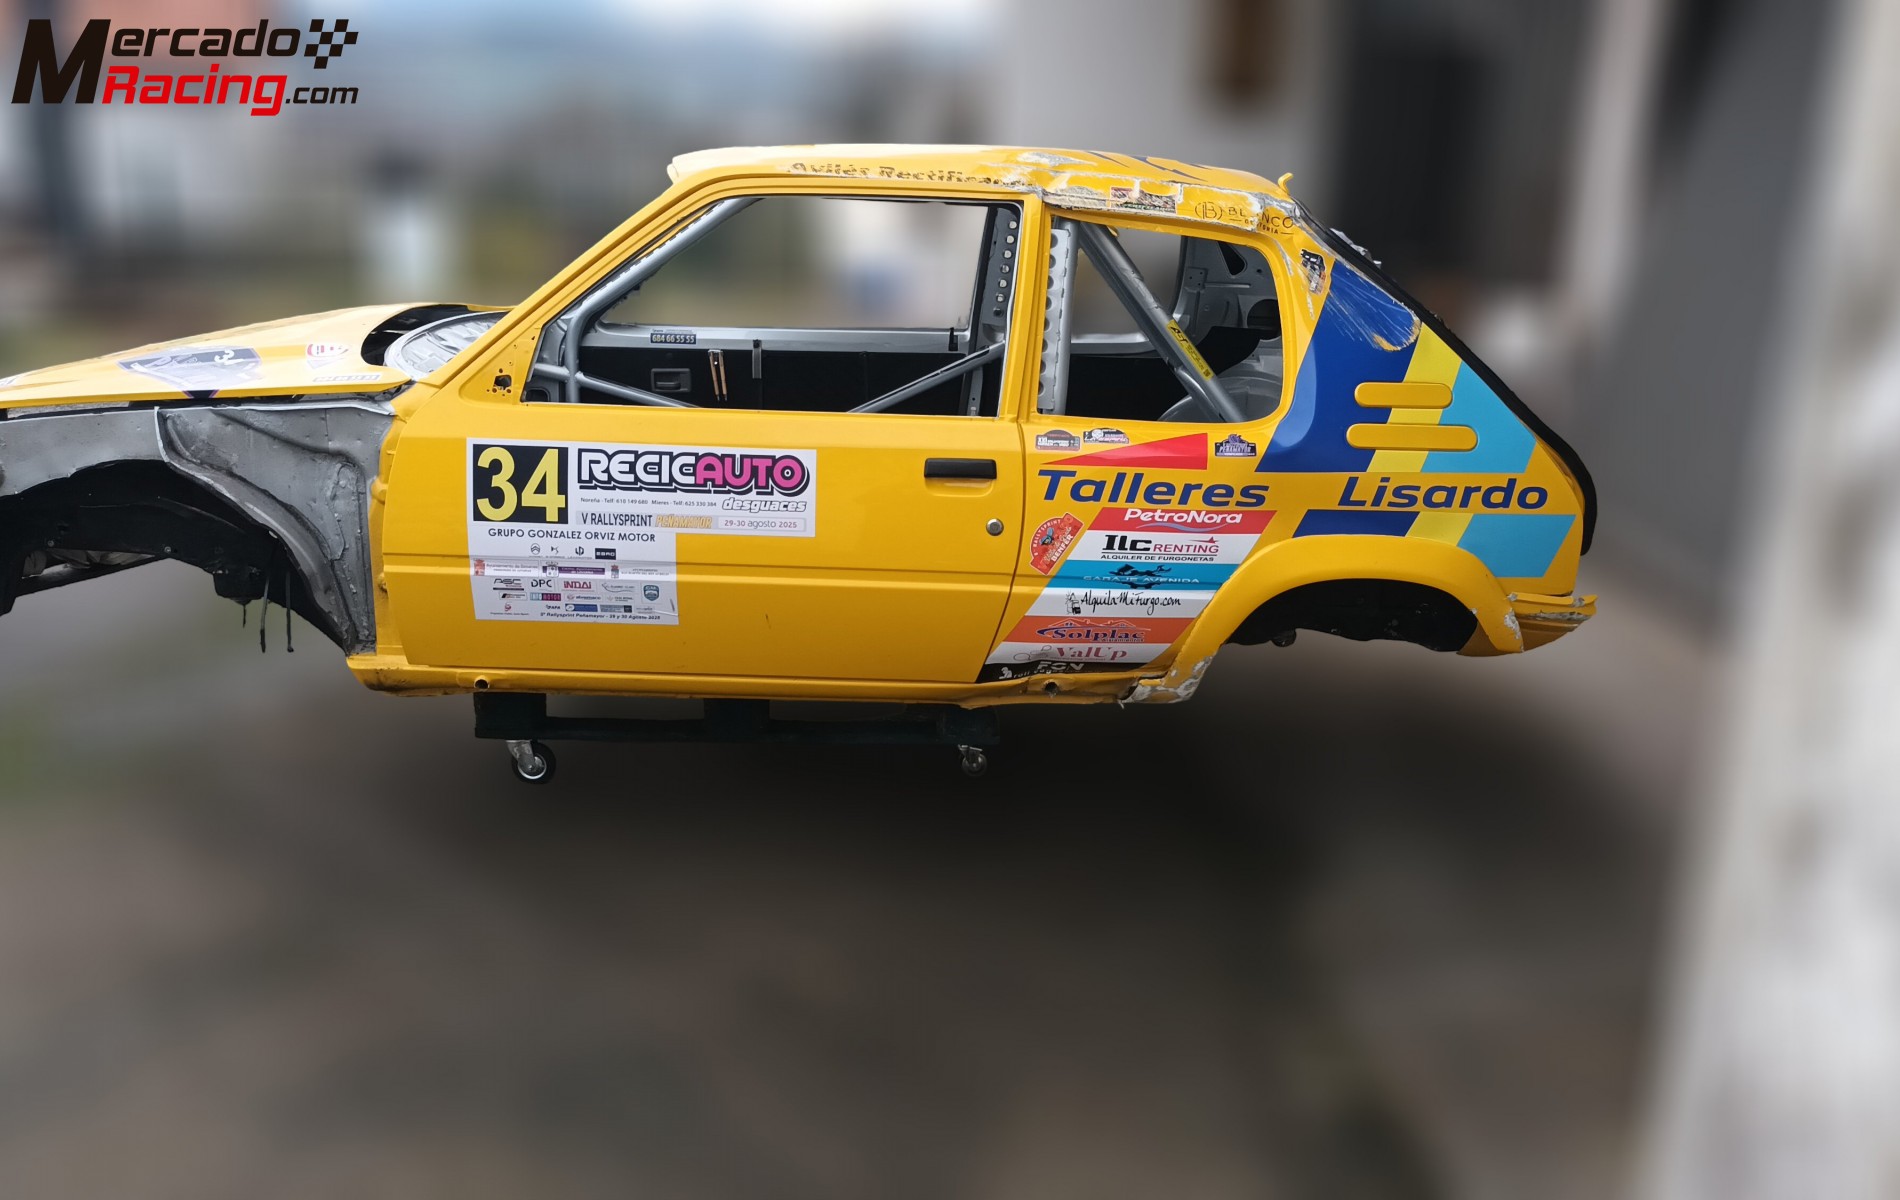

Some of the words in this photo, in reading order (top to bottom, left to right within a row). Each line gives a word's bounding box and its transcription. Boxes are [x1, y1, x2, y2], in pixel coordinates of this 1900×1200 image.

[1228, 206, 1294, 229] BLNCO
[476, 446, 566, 522] 34
[1038, 469, 1270, 507] Talleres
[1337, 476, 1548, 509] Lisardo
[722, 497, 807, 513] desguaces
[581, 512, 588, 524] V
[590, 513, 652, 526] RALLYSPRINT
[655, 513, 713, 528] PEÑAMAYOR
[724, 519, 745, 527] 29-30
[747, 519, 777, 529] agosto
[1124, 508, 1242, 524] PetroNora
[488, 528, 524, 537] GRUPO
[528, 529, 582, 539] GONZALEZ
[584, 531, 615, 540] ORVIZ
[618, 532, 656, 542] MOTOR
[1153, 543, 1219, 553] RENTING
[531, 579, 552, 588] DPC
[1052, 629, 1145, 642] Solplac
[1056, 647, 1128, 660] ValUp
